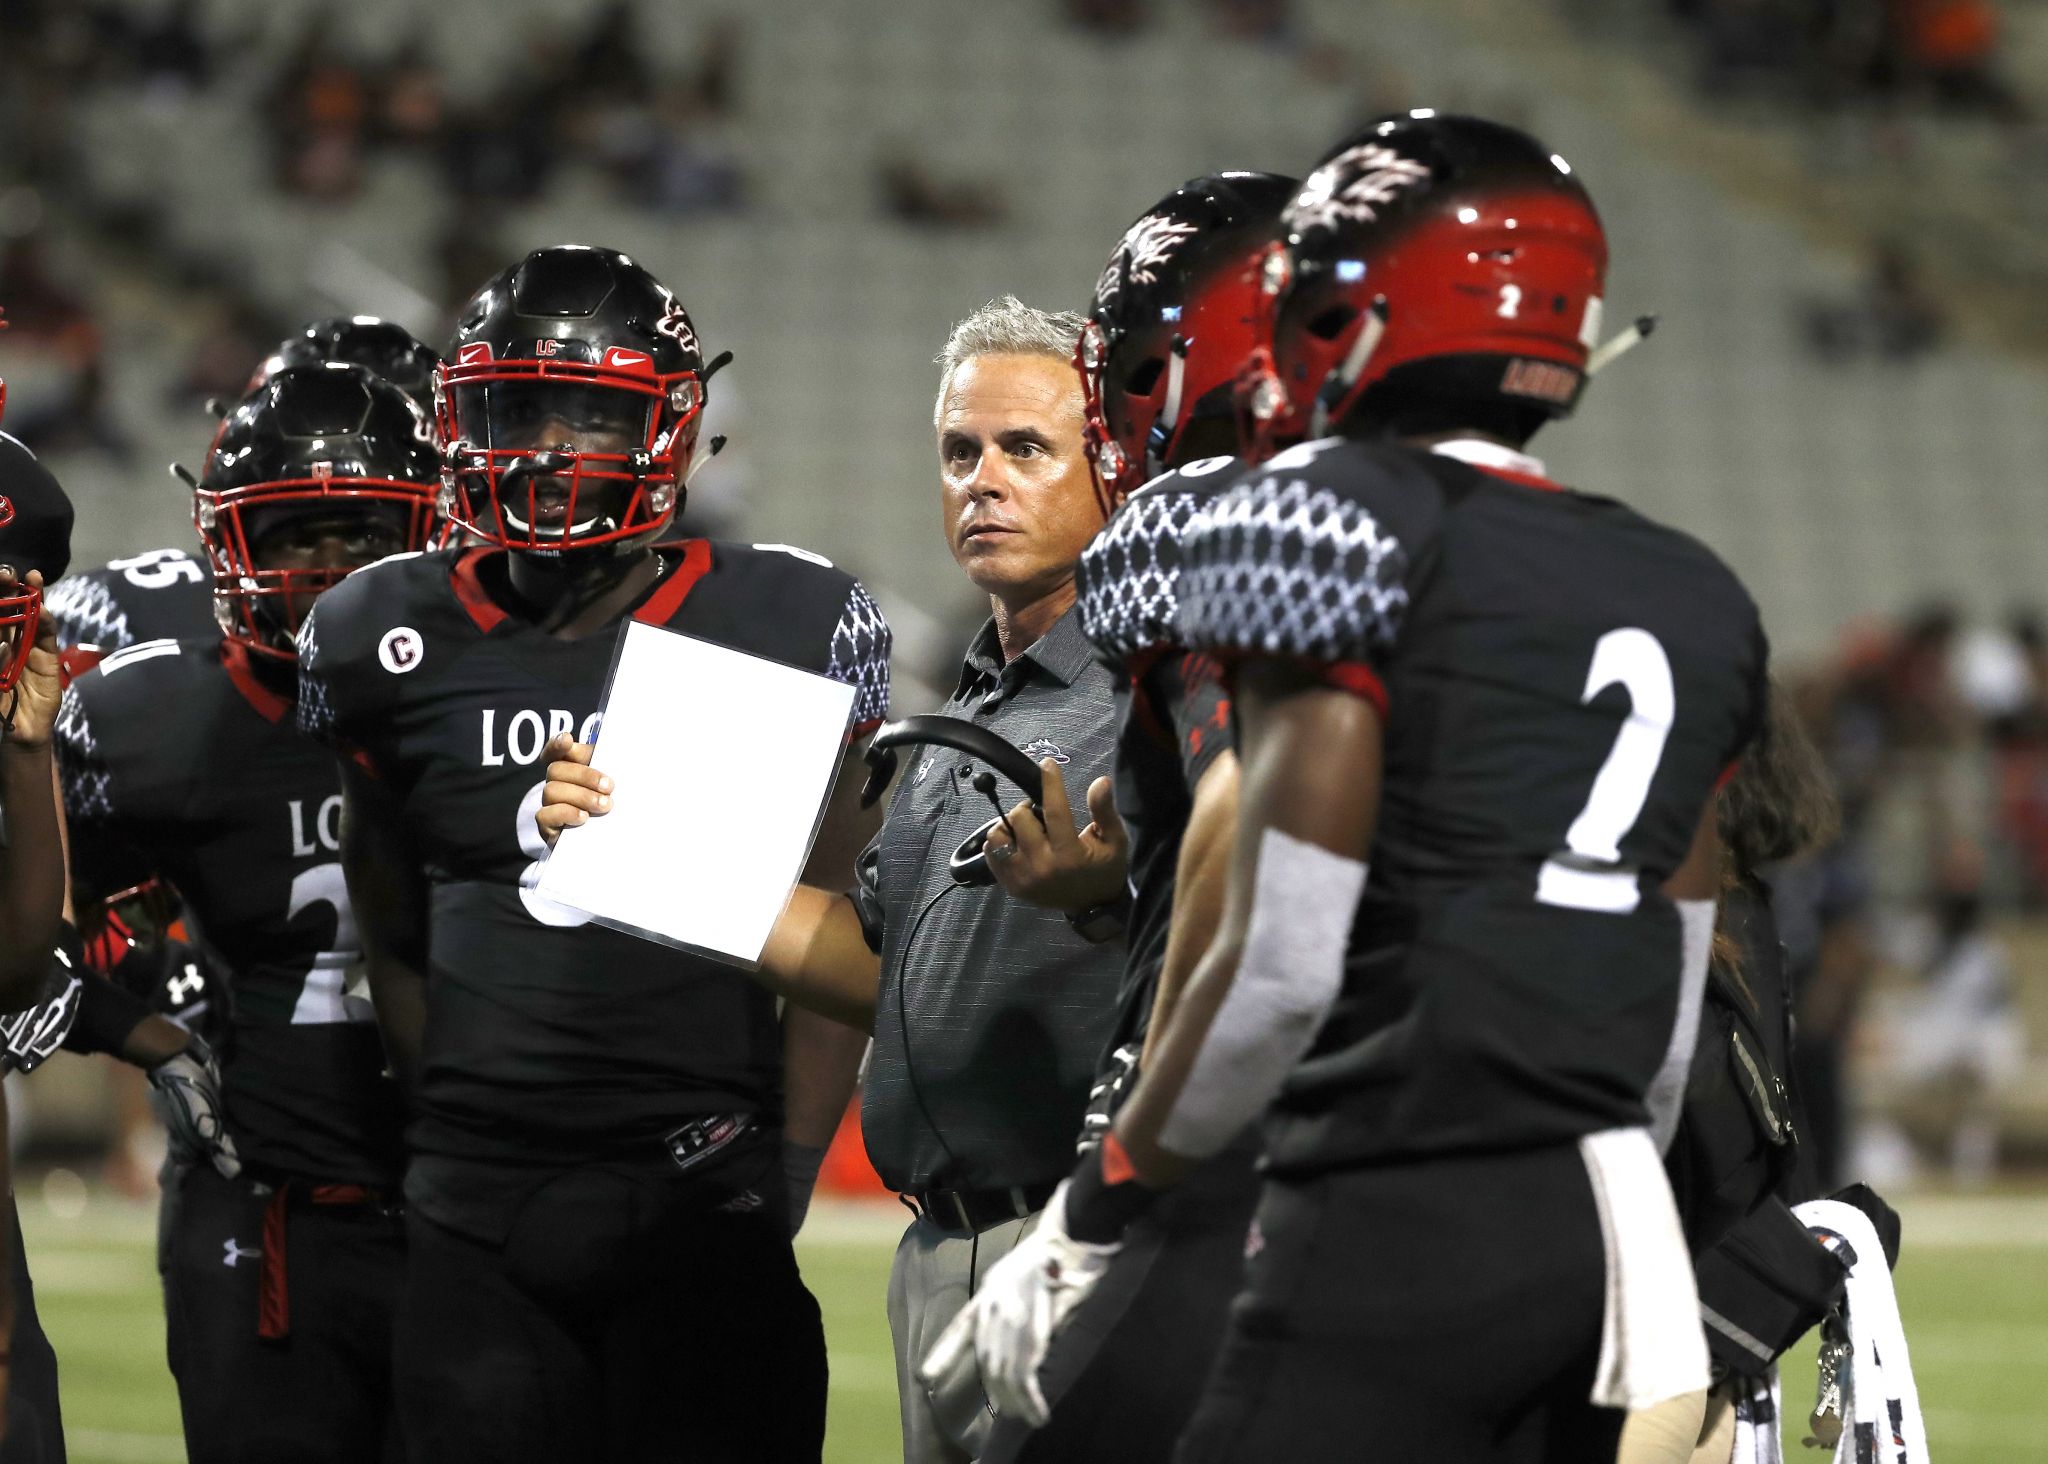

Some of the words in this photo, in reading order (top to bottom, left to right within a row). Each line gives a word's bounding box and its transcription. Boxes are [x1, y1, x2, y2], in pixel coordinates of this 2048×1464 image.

[535, 339, 557, 356] LC
[387, 633, 416, 668] C
[1534, 626, 1675, 914] 2
